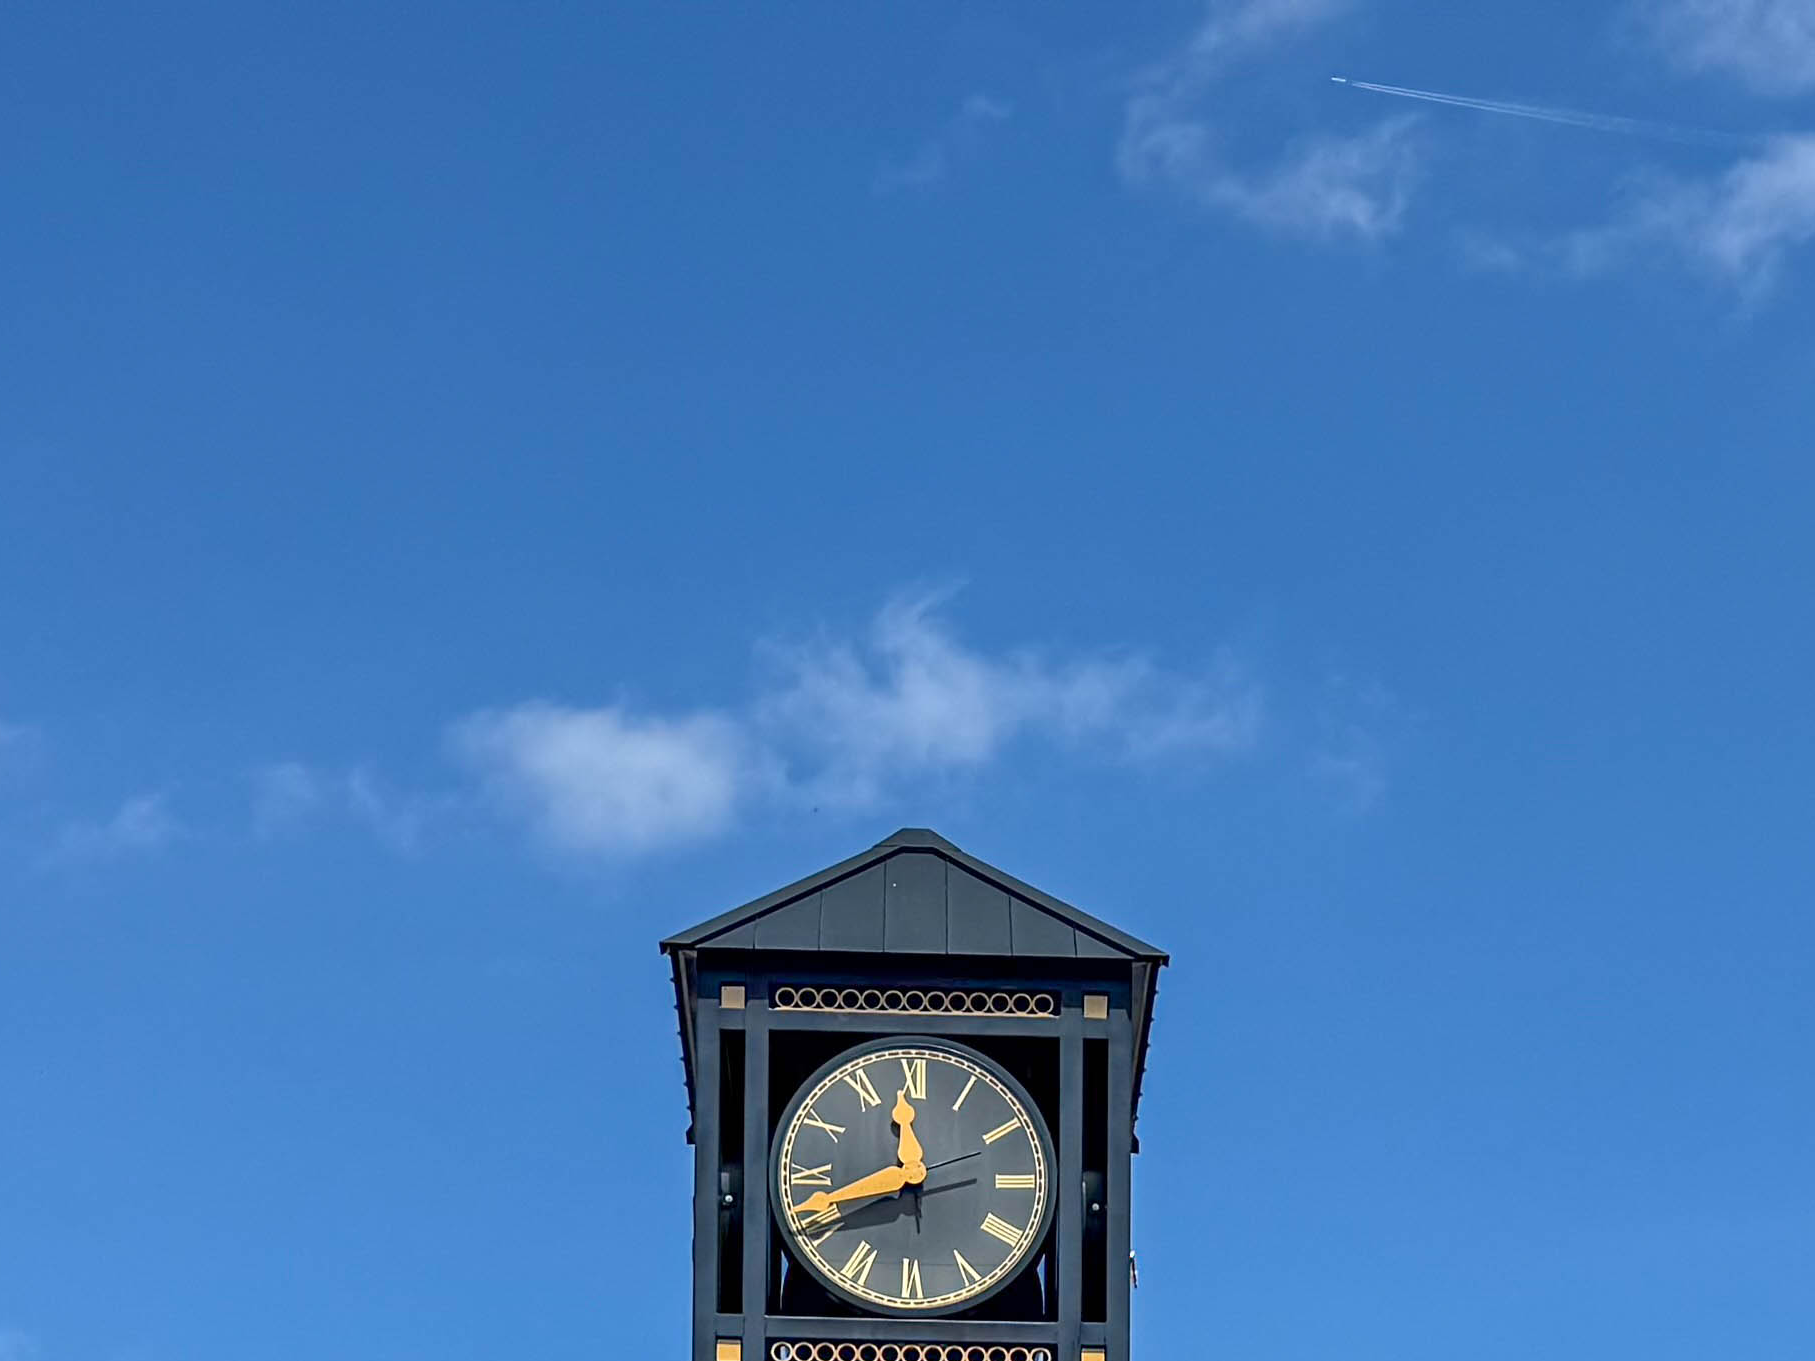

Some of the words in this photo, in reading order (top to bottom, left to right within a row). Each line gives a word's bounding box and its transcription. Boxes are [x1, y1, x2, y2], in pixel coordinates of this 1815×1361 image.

[843, 1067, 882, 1113] XI
[900, 1059, 927, 1100] XII
[803, 1108, 846, 1143] X
[982, 1116, 1022, 1145] II
[791, 1163, 833, 1186] IX
[995, 1174, 1036, 1189] III
[901, 1257, 925, 1299] VI
[952, 1249, 983, 1287] V
